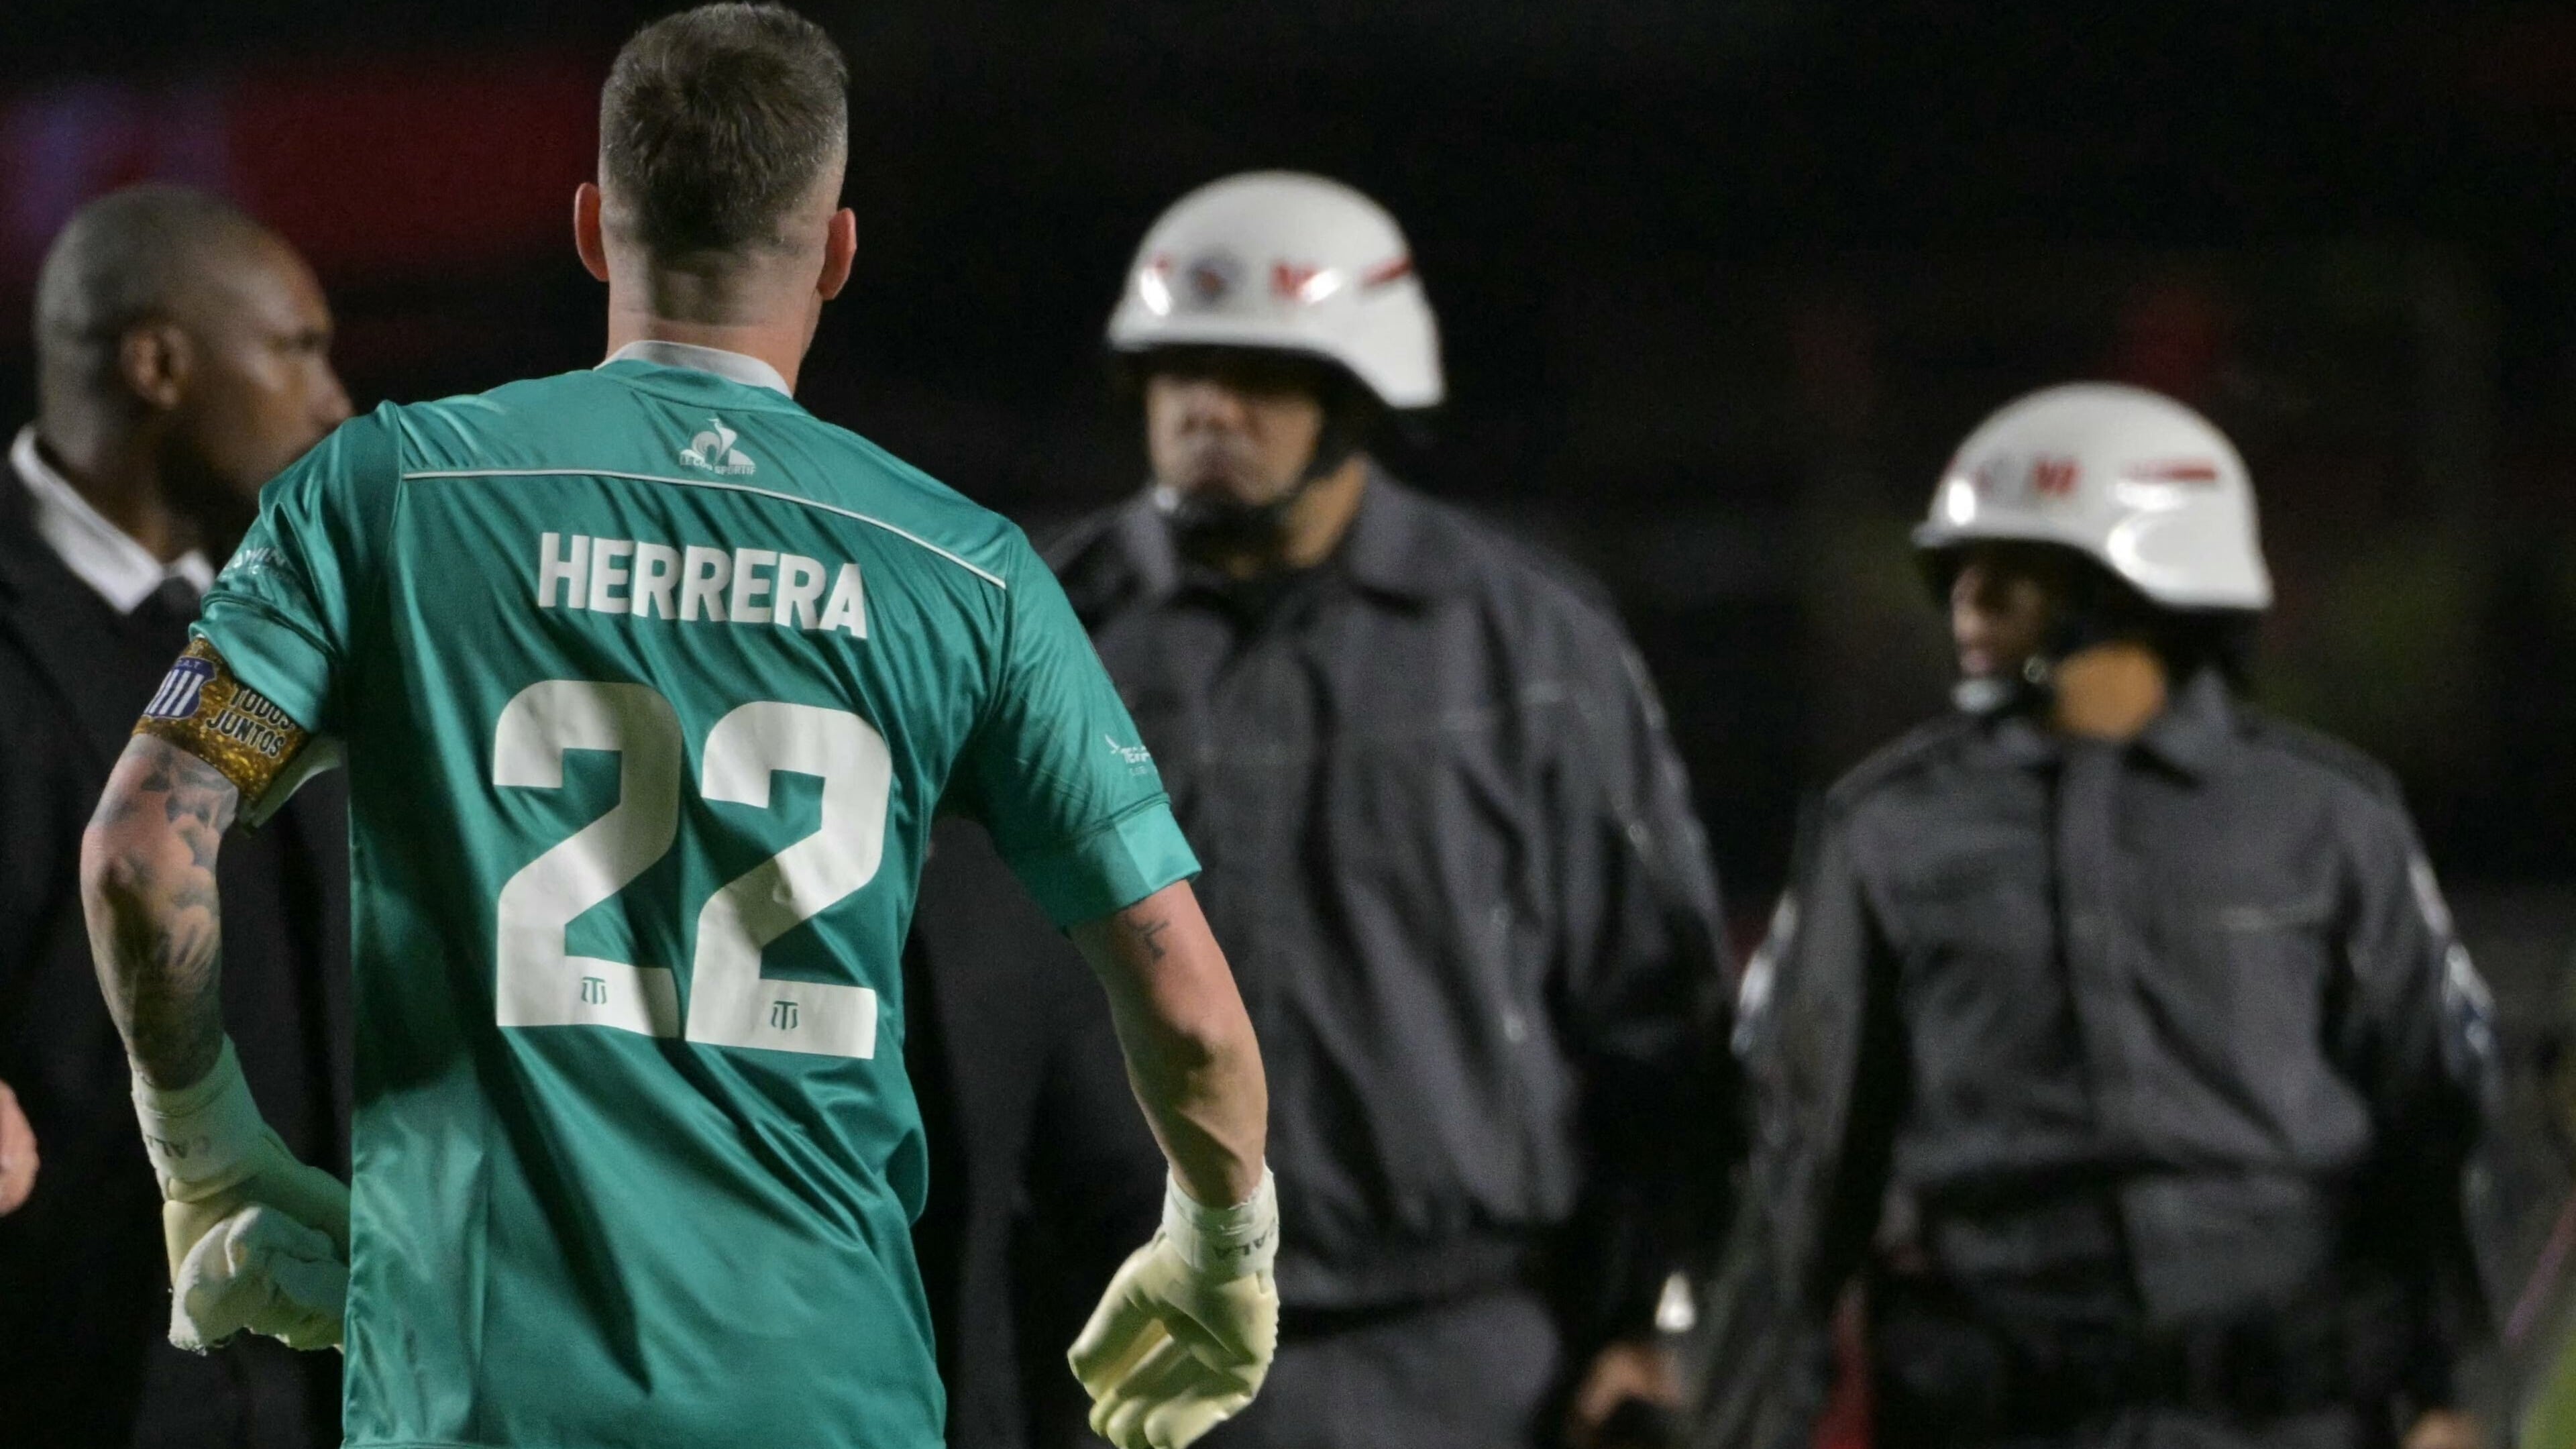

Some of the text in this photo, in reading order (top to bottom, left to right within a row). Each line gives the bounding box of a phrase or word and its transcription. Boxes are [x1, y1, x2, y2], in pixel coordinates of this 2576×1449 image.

[538, 532, 867, 639] HERRERA
[207, 709, 285, 758] JUNTOS
[494, 679, 893, 1059] 22
